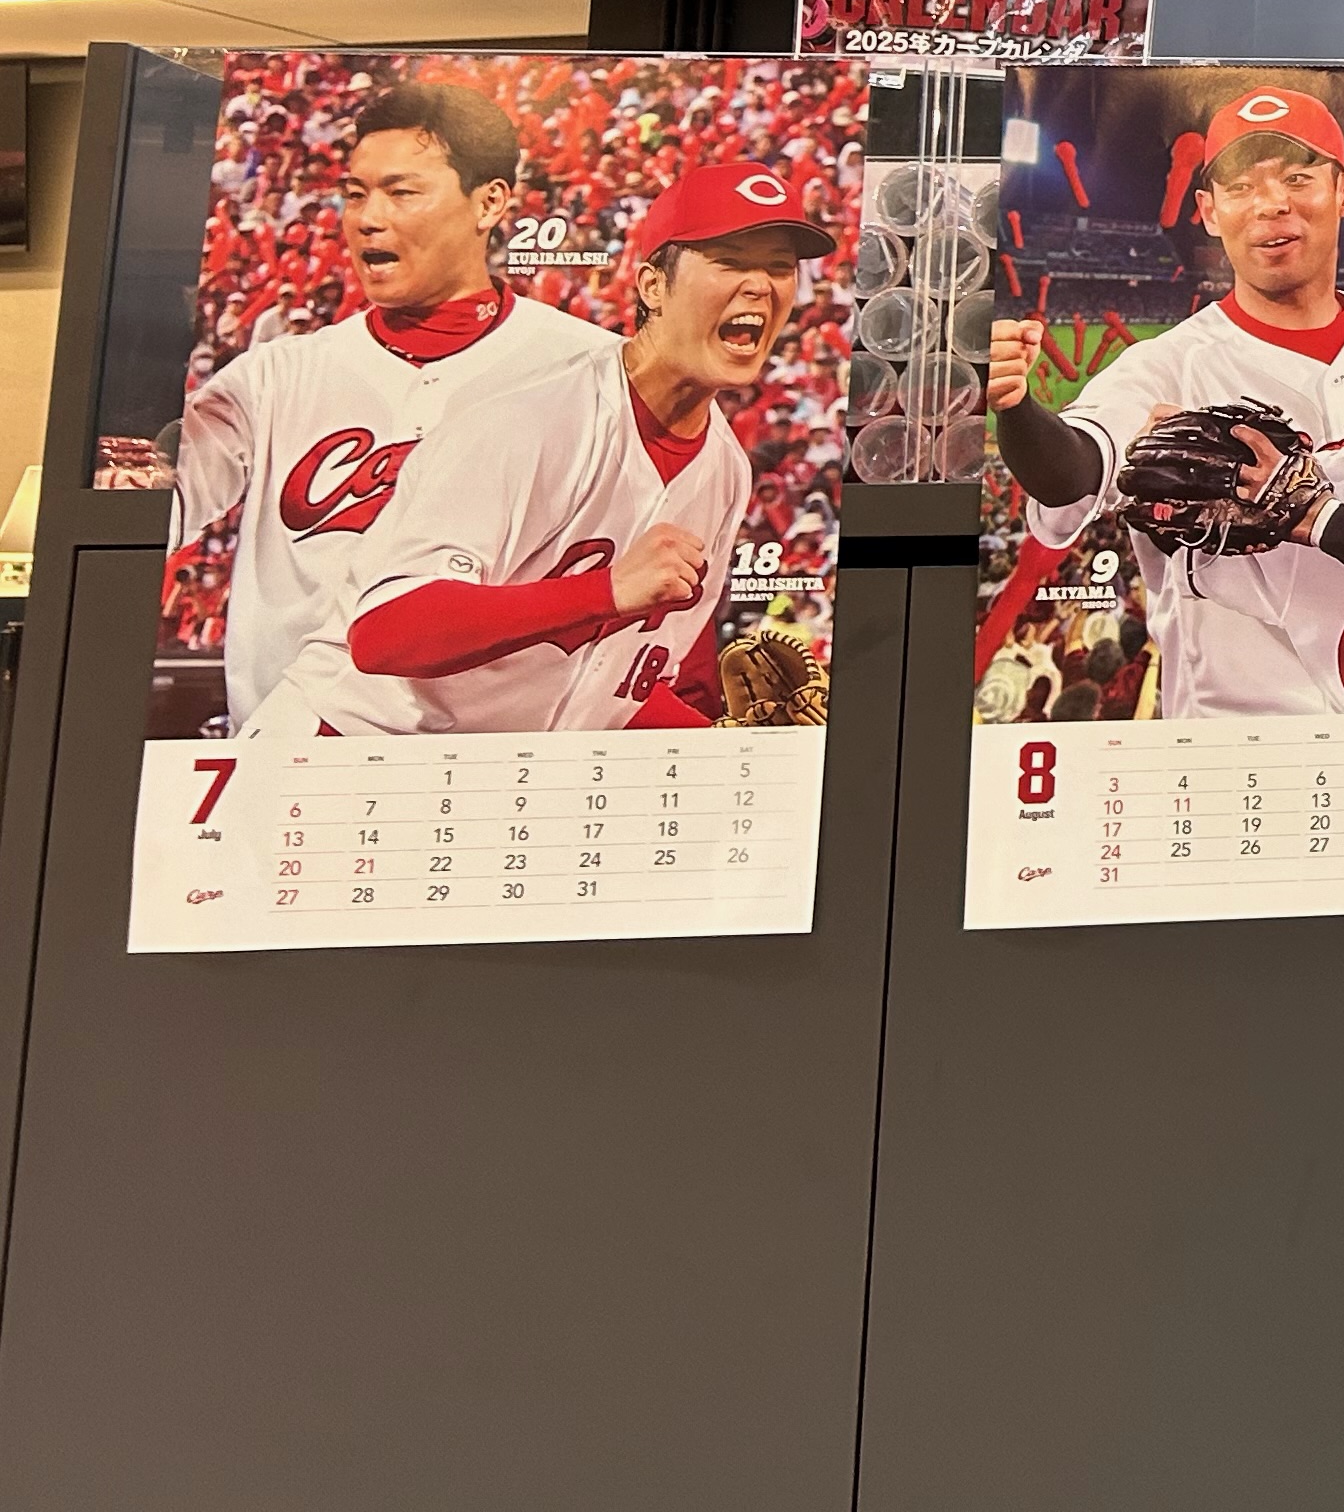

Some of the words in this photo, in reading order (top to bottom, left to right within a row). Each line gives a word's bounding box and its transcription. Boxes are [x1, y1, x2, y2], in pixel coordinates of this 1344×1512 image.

[507, 217, 567, 250] 20
[508, 252, 609, 266] KURIBAYASHI
[476, 301, 498, 322] 20
[731, 542, 783, 576] 18
[1090, 550, 1119, 584] 9
[730, 577, 825, 592] MORISHITA
[1035, 586, 1117, 601] AKIYAMA
[614, 643, 669, 702] 18
[1017, 741, 1057, 805] 8
[188, 758, 238, 824] 7
[1018, 809, 1055, 821] August
[1104, 800, 1123, 815] 10
[1174, 798, 1190, 813] 11
[1243, 795, 1262, 810] 12
[1312, 793, 1331, 808] 13
[197, 829, 221, 842] July
[283, 831, 304, 847] 13
[358, 830, 379, 845] 14
[433, 827, 454, 843] 15
[508, 825, 529, 841] 16
[583, 823, 604, 839] 17
[658, 821, 679, 837] 18
[732, 819, 752, 834] 19
[1101, 845, 1121, 860] 24
[1170, 842, 1191, 857] 25
[1240, 840, 1261, 855] 26
[1309, 837, 1329, 852] 27
[279, 860, 302, 876] 20
[354, 858, 374, 874] 21
[429, 856, 452, 872] 22
[504, 854, 527, 870] 23
[579, 852, 601, 868] 24
[654, 850, 676, 865] 25
[727, 848, 749, 863] 26
